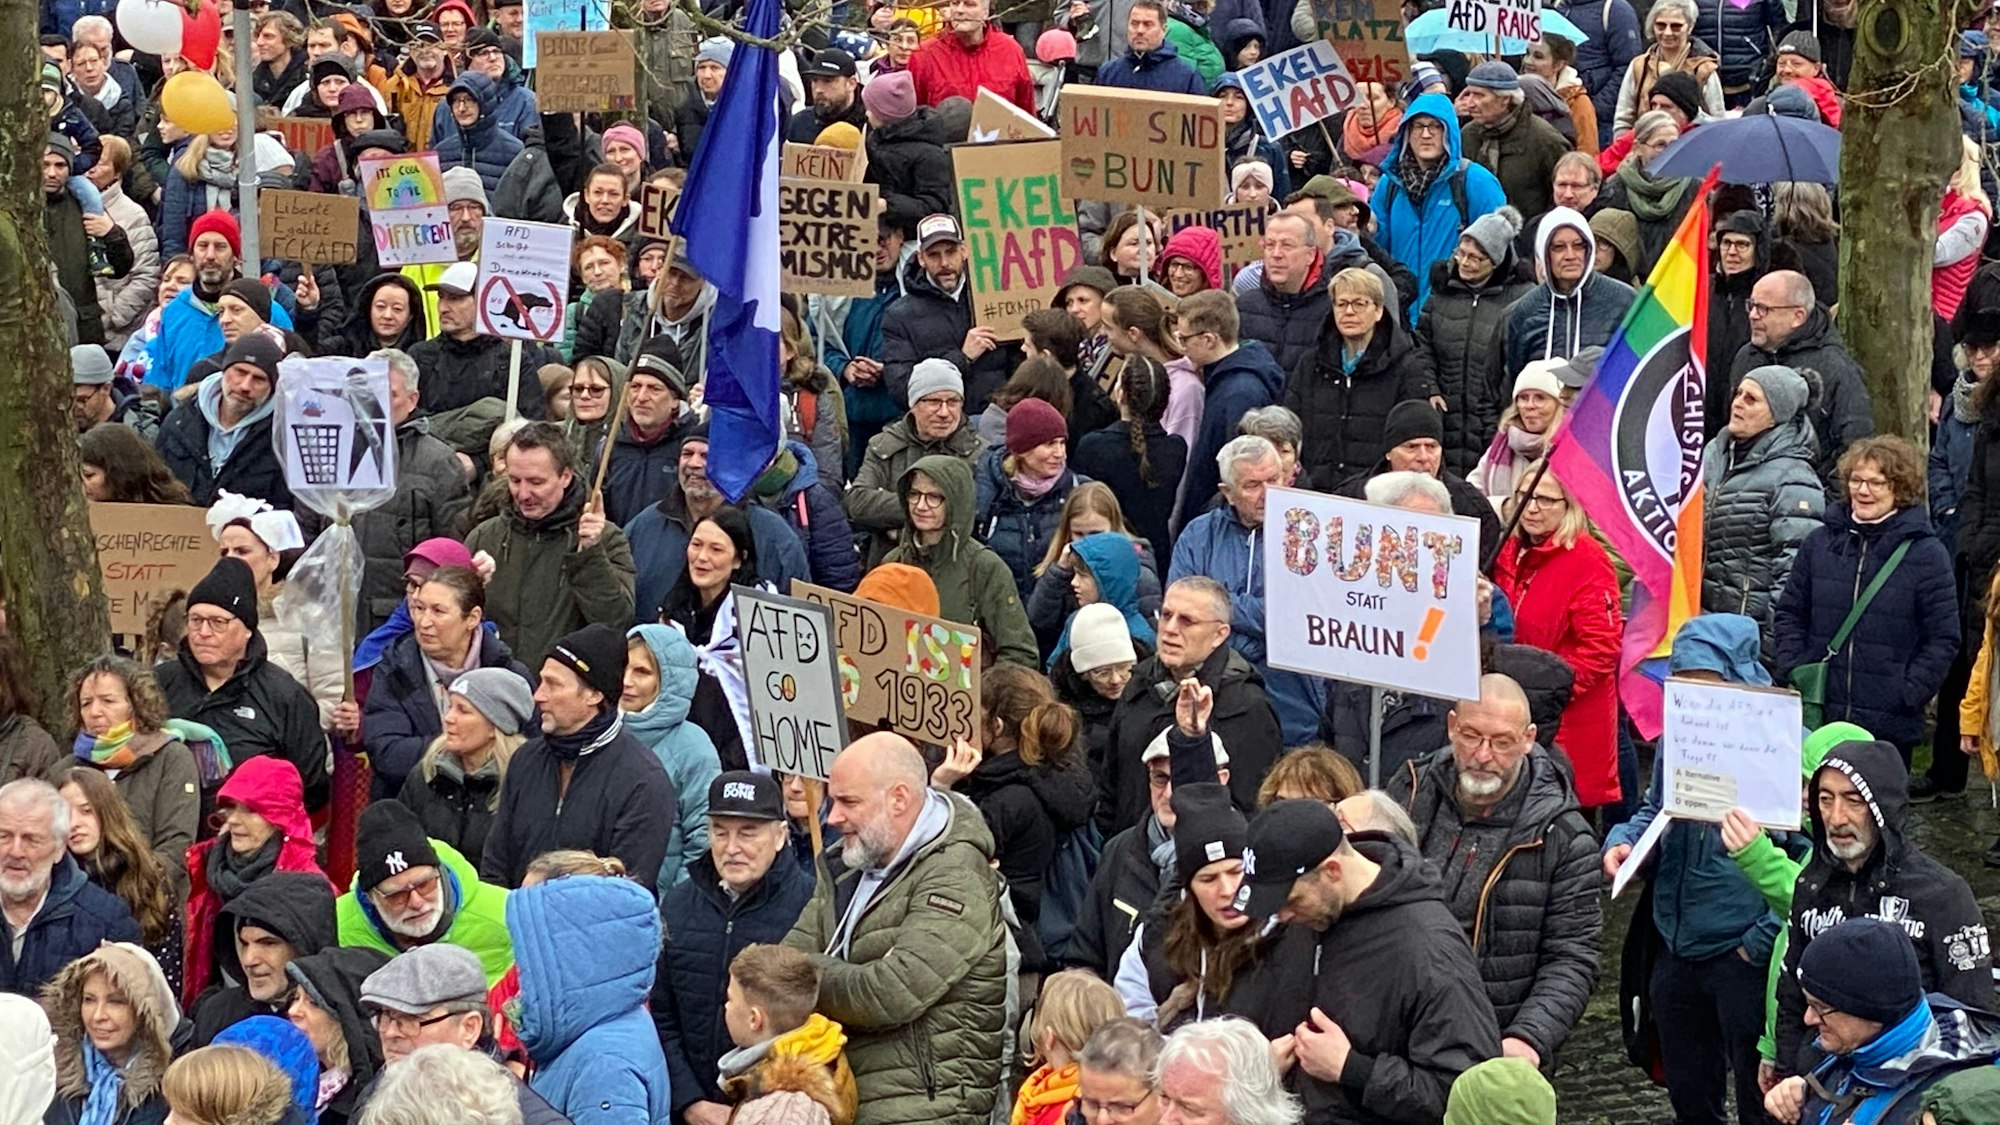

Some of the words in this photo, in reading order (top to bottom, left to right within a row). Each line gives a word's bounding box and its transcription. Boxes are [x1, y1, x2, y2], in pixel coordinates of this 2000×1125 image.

[1317, 19, 1404, 42] PLATZ
[1448, 0, 1486, 32] AfD
[1498, 7, 1541, 42] RAUS
[1242, 46, 1338, 99] EKEL
[1346, 54, 1402, 83] AZIS
[1073, 106, 1131, 140] WIR
[1148, 111, 1219, 149] SIND
[1257, 74, 1356, 138] HAfD
[795, 153, 844, 180] KEIN
[1104, 152, 1203, 197] BUNT
[779, 186, 871, 220] GEGEN
[961, 173, 1075, 230] EKEL
[970, 227, 1084, 293] HAfD
[105, 561, 177, 581] STATT
[1283, 507, 1463, 601] BUNT
[1346, 591, 1388, 611] STATT
[904, 618, 978, 690] IST
[766, 671, 797, 703] GO
[875, 668, 973, 746] 1933
[755, 710, 836, 779] HOME
[723, 787, 755, 801] DONE
